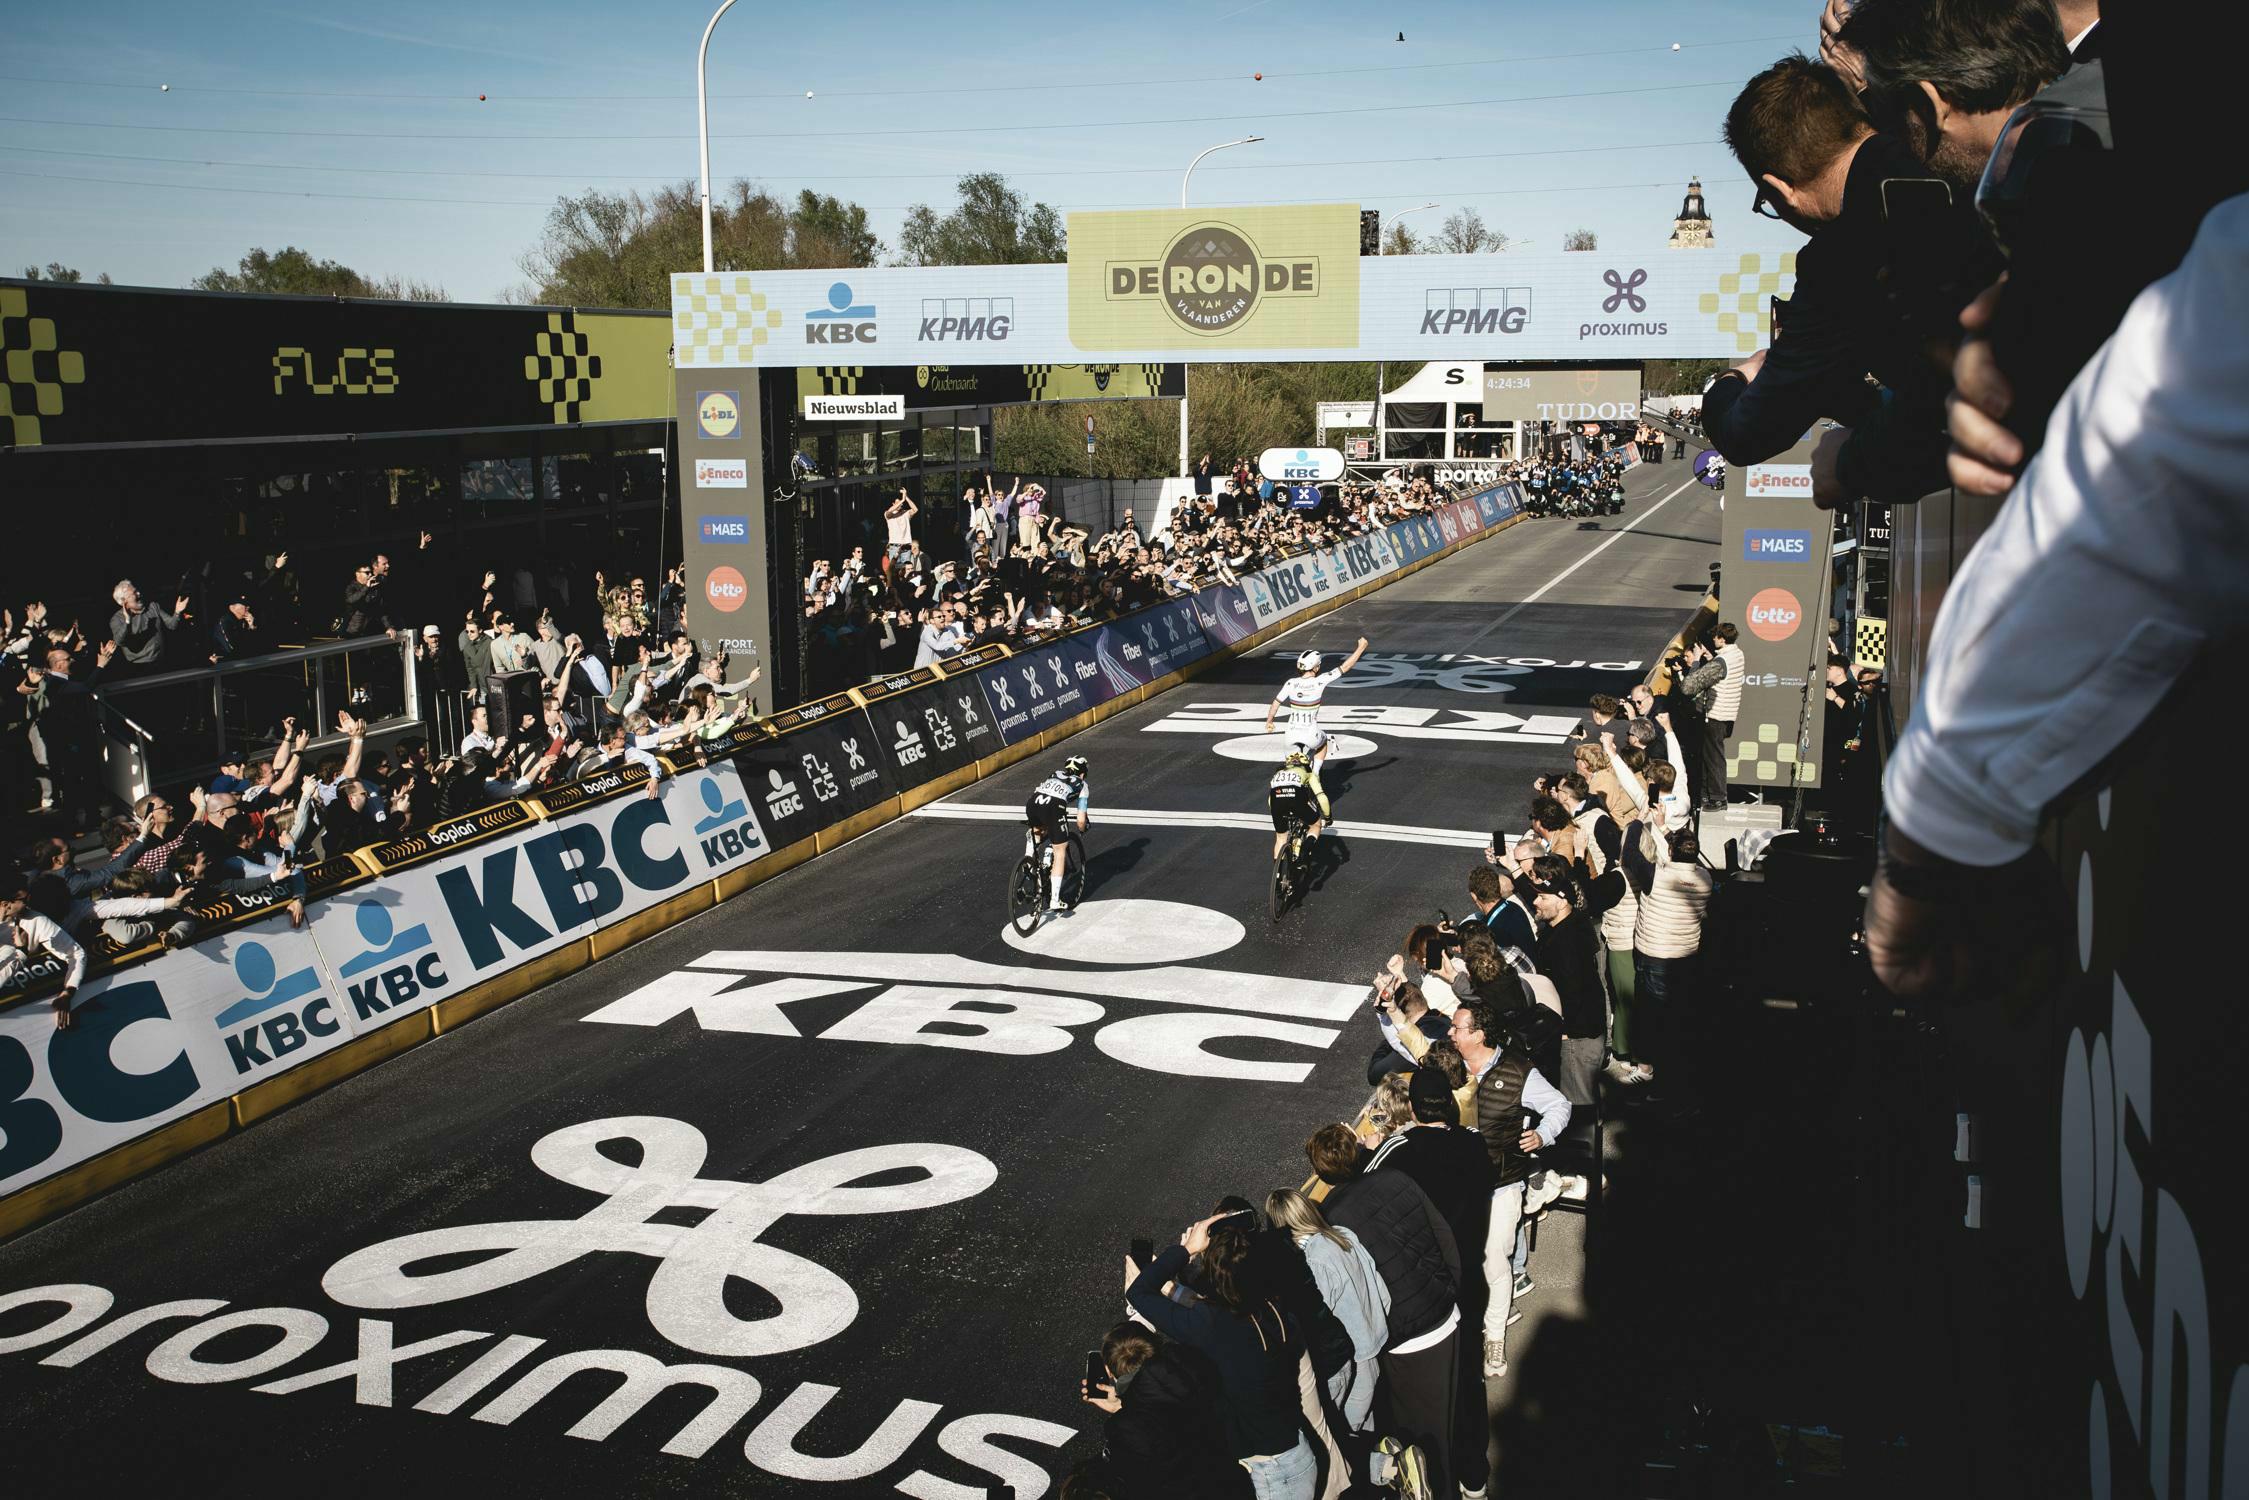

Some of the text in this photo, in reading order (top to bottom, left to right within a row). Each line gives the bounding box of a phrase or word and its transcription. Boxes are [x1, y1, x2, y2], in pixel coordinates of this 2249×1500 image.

[1177, 298, 1246, 324] VLAANDEREN
[1200, 299, 1221, 309] VAN
[918, 315, 1011, 341] KPMG
[1420, 305, 1527, 335] KPMG
[1580, 321, 1667, 339] proximus
[806, 322, 877, 343] KBC
[1487, 378, 1531, 389] 4:24:34
[811, 402, 897, 414] Nieuwsblad
[1537, 402, 1637, 420] TUDOR
[708, 468, 743, 479] Eneco
[1285, 468, 1319, 478] KBC
[1762, 474, 1810, 488] Eneco
[712, 524, 744, 536] MAES
[1762, 539, 1804, 553] MAES
[1344, 539, 1380, 579] KBC
[1265, 563, 1313, 610] KBC
[1314, 579, 1330, 593] KBC
[1258, 602, 1273, 617] KBC
[1122, 643, 1142, 661] fiber
[1075, 660, 1098, 680] fiber
[885, 676, 911, 690] boplan
[799, 704, 827, 720] boplan
[1000, 688, 1081, 733] proximus proximus proximus
[965, 724, 989, 742] proximus
[897, 743, 927, 767] KBC
[582, 772, 622, 794] boplan
[850, 769, 878, 791] proximus
[769, 793, 804, 821] KBC
[427, 820, 477, 845] boplan
[700, 820, 761, 868] KBC
[436, 797, 691, 970] KBC
[347, 951, 450, 1022] KBC
[224, 997, 341, 1076] KBC
[580, 972, 1341, 1083] KBC
